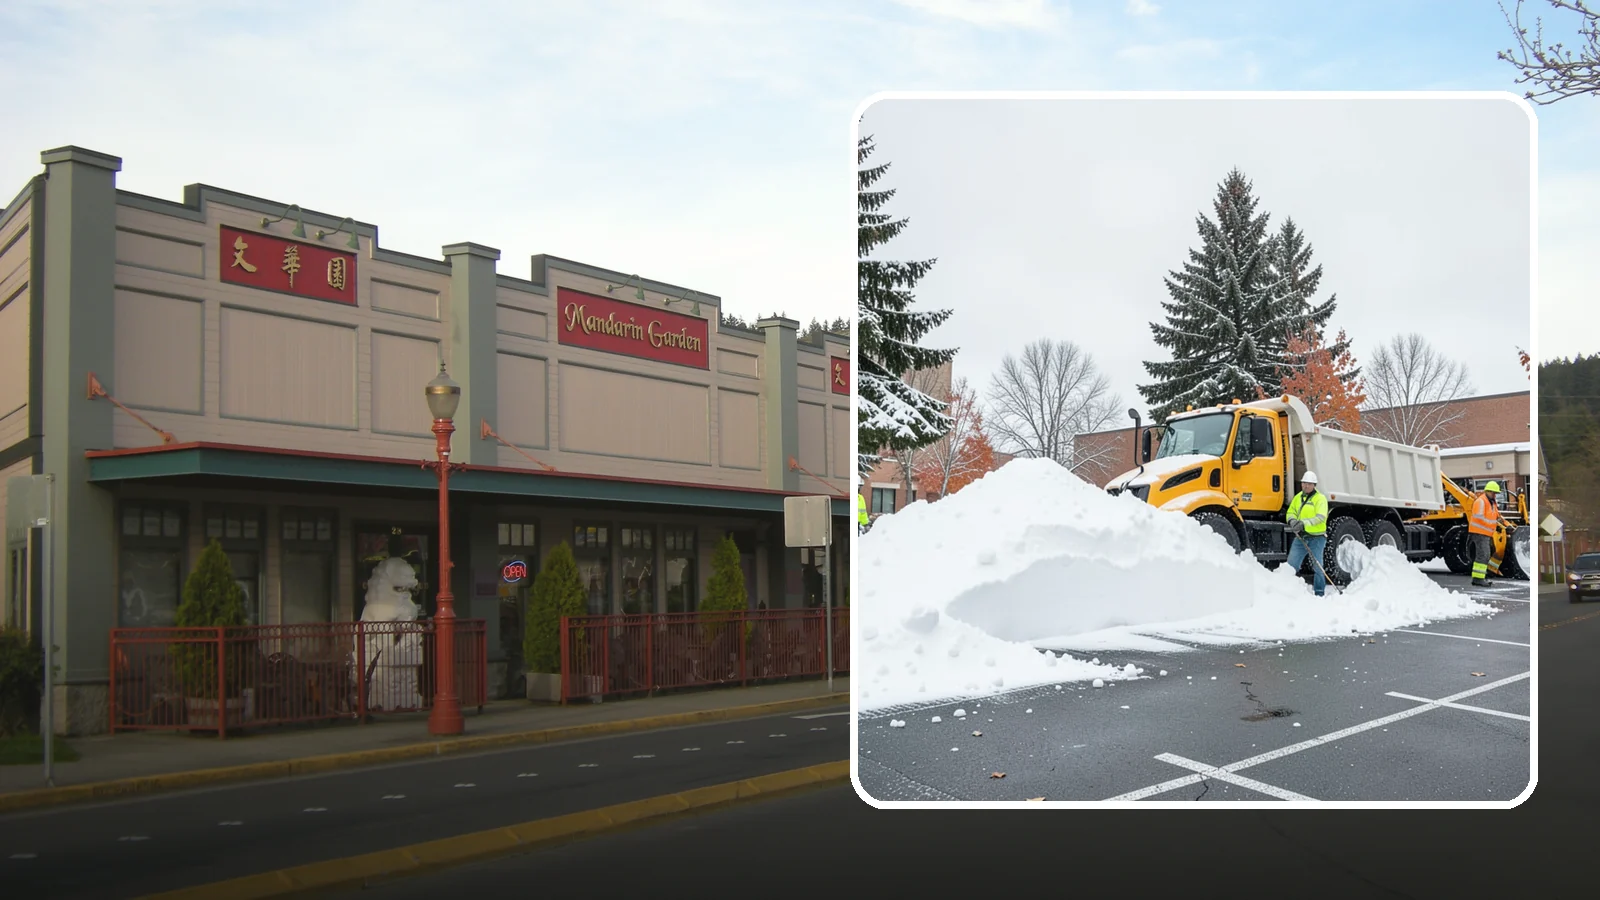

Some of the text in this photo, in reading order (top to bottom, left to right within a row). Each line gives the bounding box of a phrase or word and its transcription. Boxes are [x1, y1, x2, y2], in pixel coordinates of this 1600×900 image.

[231, 235, 346, 291] 文華園
[564, 302, 702, 352] Mandarin Garden
[503, 565, 527, 578] OPEN
